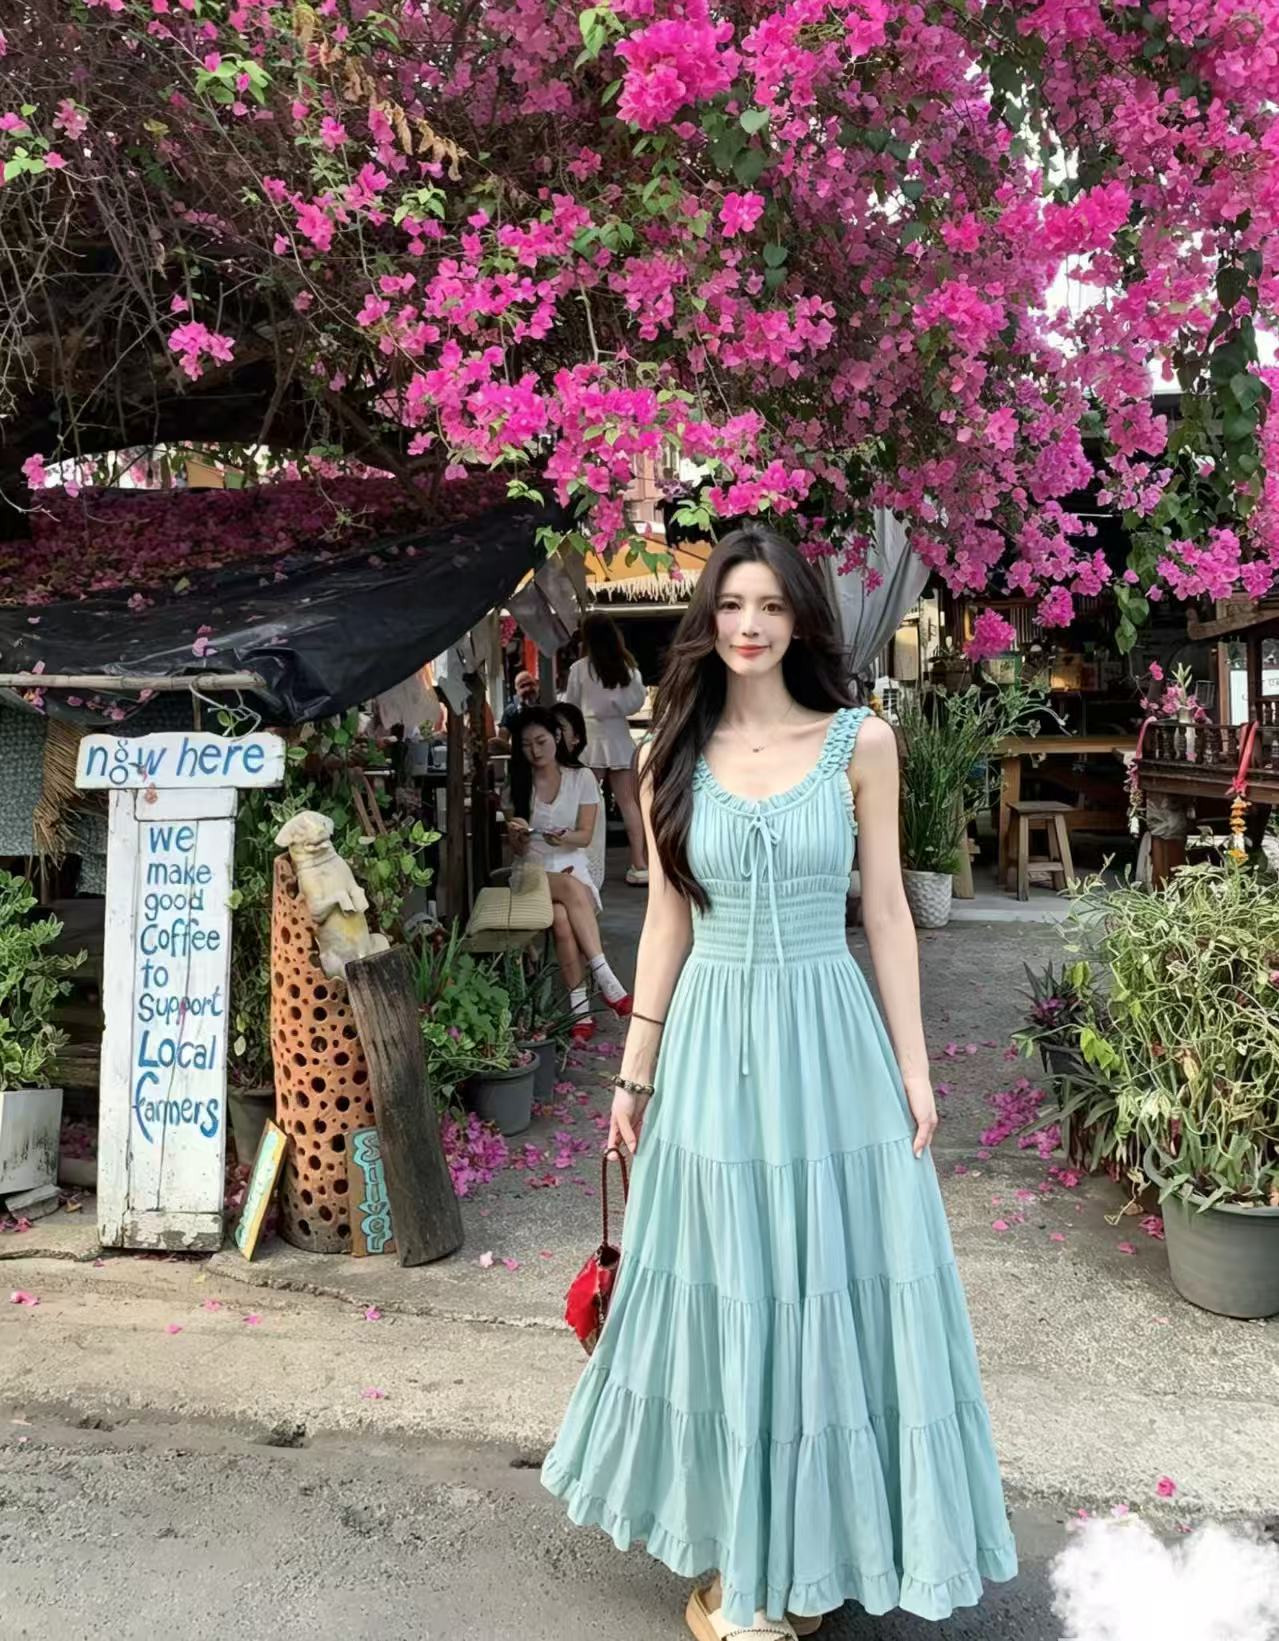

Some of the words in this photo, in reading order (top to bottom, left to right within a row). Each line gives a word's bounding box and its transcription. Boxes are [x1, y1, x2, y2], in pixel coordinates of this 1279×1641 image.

[175, 736, 265, 777] here
[149, 825, 195, 853] we
[146, 856, 213, 885] make
[144, 888, 204, 922] good
[140, 957, 169, 989] to
[138, 1029, 217, 1070] Local
